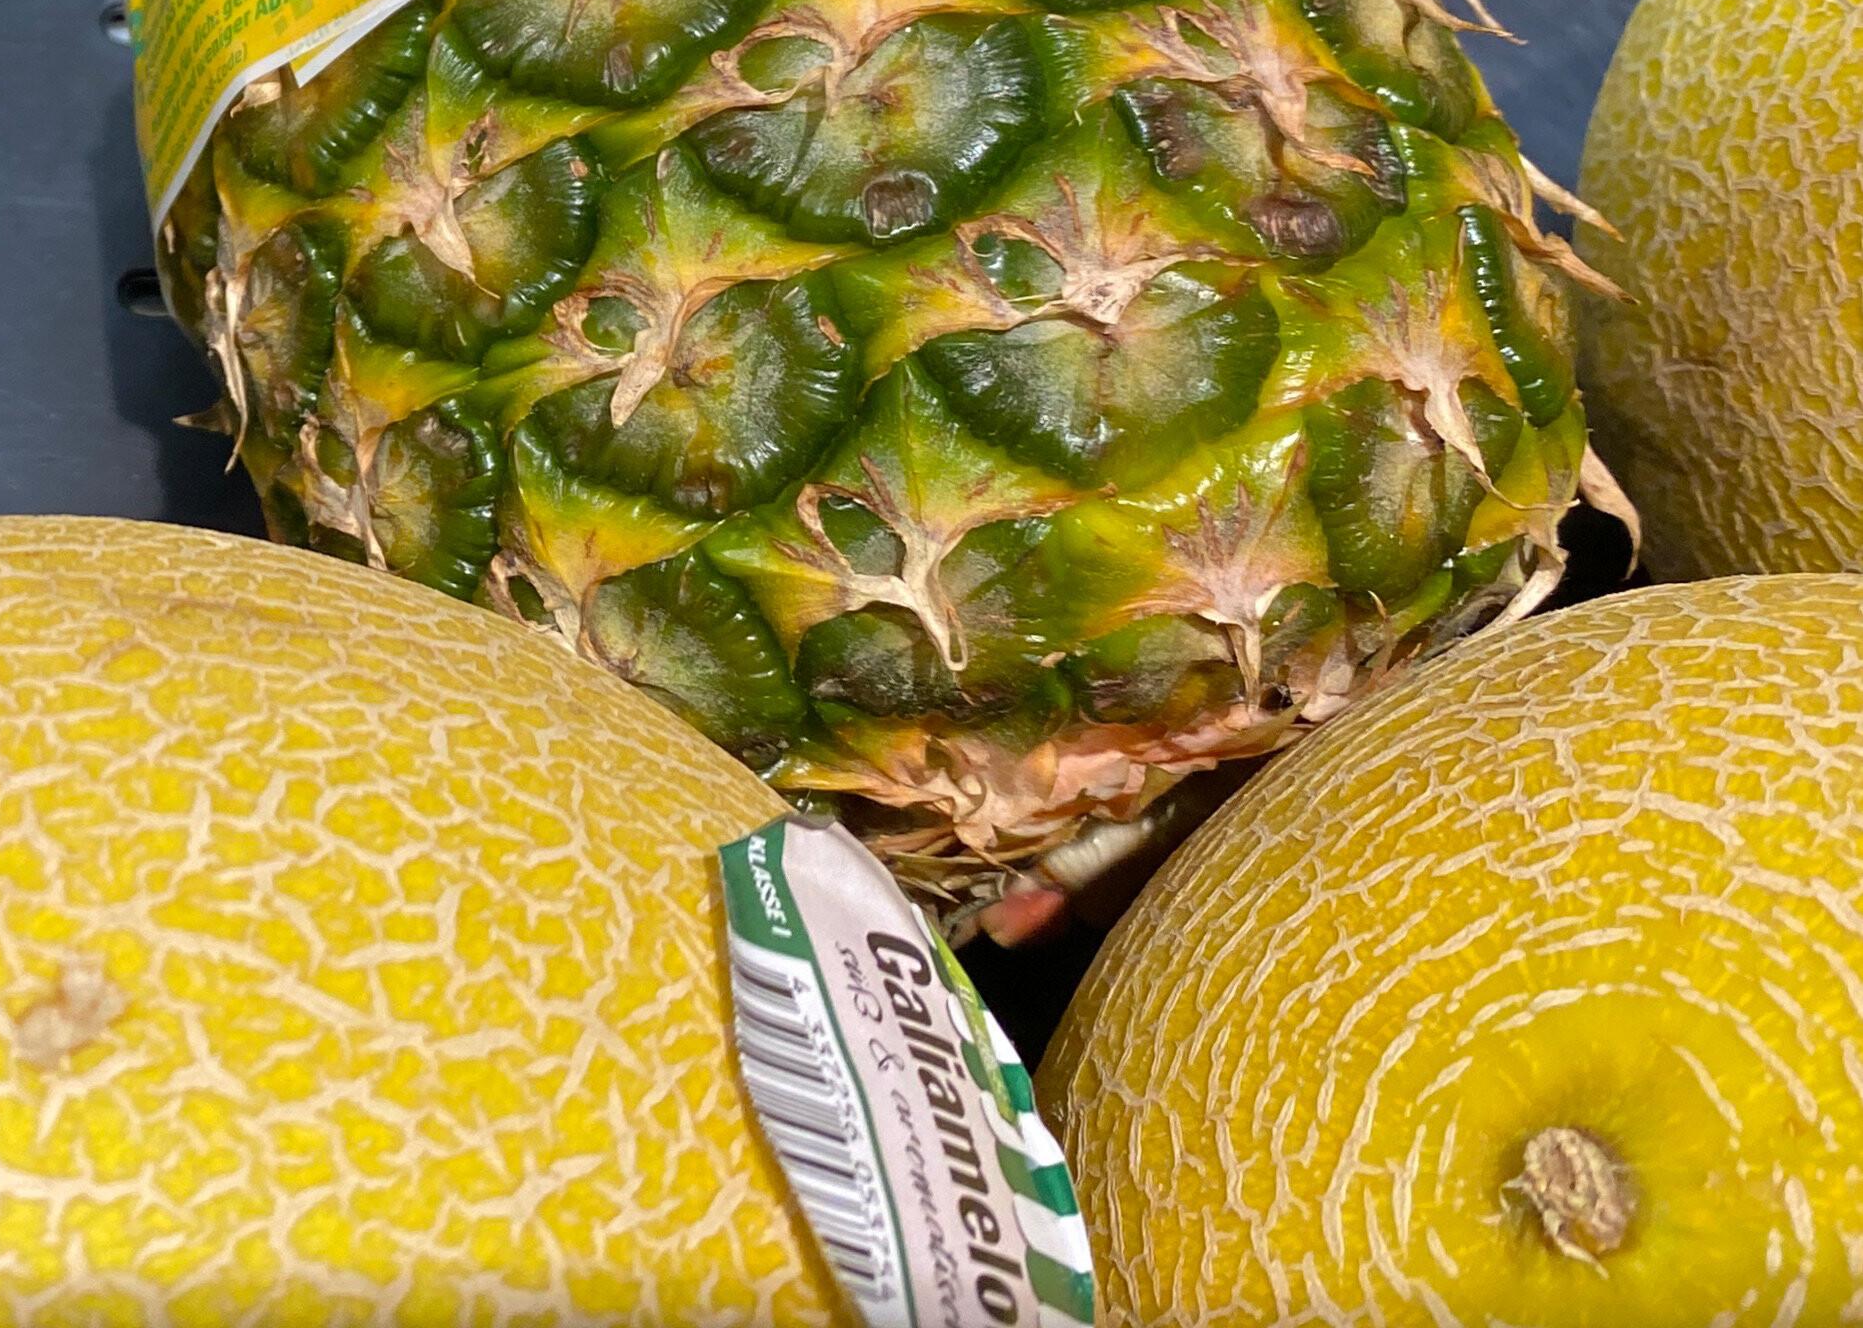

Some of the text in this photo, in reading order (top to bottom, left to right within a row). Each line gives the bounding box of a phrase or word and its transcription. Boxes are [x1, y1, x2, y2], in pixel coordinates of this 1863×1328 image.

[746, 835, 787, 924] KLASSE
[836, 940, 884, 1025] süß
[869, 1037, 905, 1074] &
